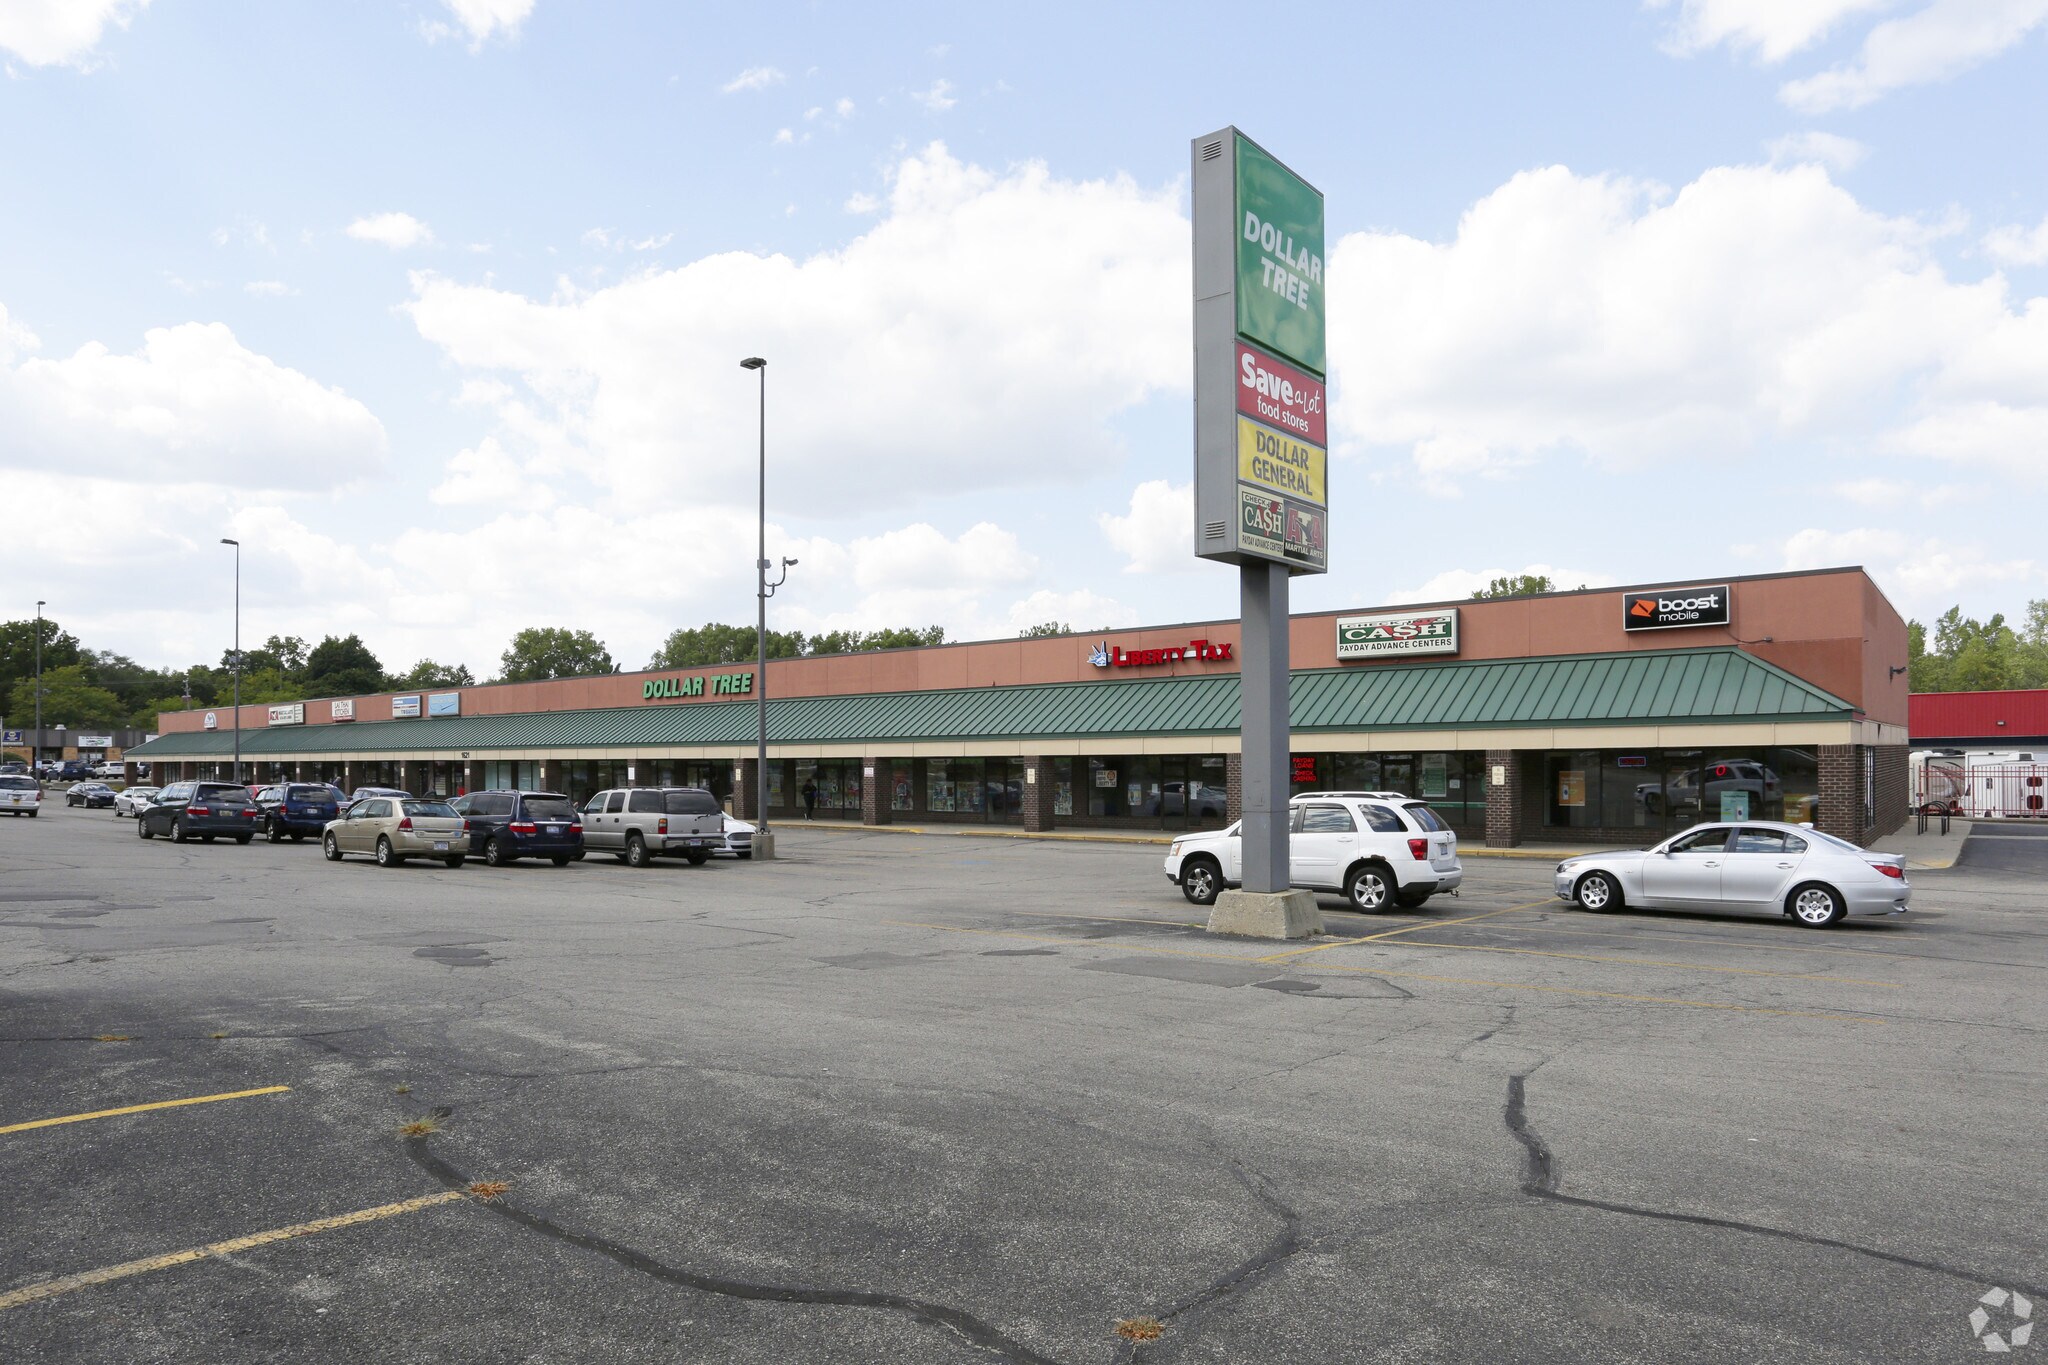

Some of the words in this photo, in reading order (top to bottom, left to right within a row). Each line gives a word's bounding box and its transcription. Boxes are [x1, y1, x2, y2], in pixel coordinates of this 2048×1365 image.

[1243, 210, 1323, 286] DOLLAR
[1260, 256, 1310, 311] TREE
[1241, 352, 1294, 406] Save
[1257, 395, 1280, 420] food
[1282, 410, 1309, 433] stores
[1255, 430, 1309, 471] DOLLAR
[1252, 455, 1313, 497] GENERAL
[1244, 494, 1266, 507] CHECK
[1284, 541, 1309, 556] MARTIAL
[1309, 548, 1324, 560] ARTS
[1658, 593, 1719, 612] boost
[1658, 610, 1700, 622] mobile
[1339, 643, 1370, 652] PAYDAY
[1371, 641, 1410, 651] ADVANCE
[1412, 638, 1452, 648] CENTERS
[642, 676, 704, 699] DOLLAR
[710, 672, 753, 695] TREE
